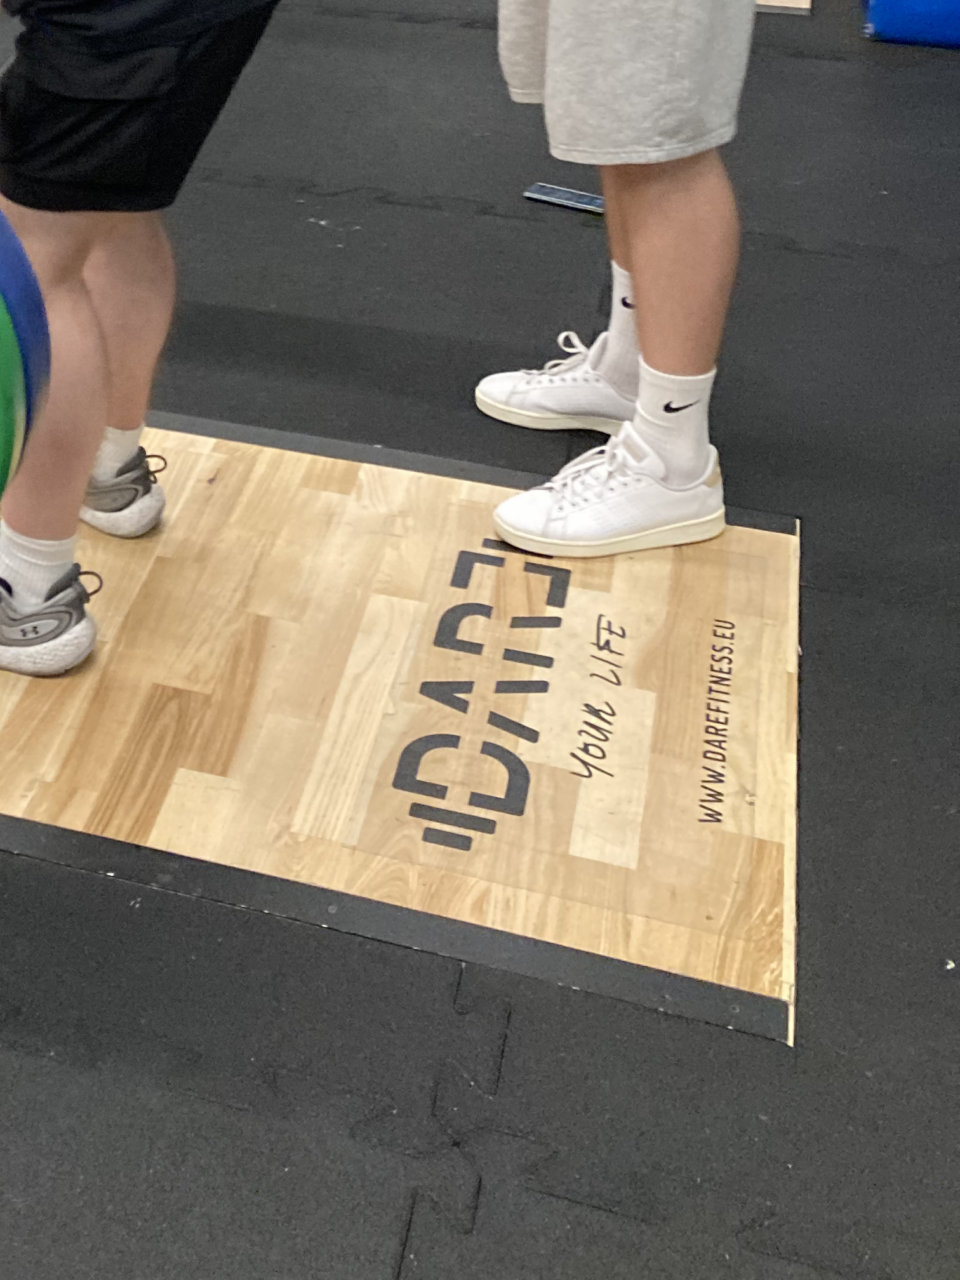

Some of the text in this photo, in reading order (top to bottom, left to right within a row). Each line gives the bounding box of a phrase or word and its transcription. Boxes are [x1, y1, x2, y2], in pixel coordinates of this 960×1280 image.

[569, 613, 628, 779] YOUR LIFE
[697, 618, 737, 824] WWW.DAREFITNESS.EU
